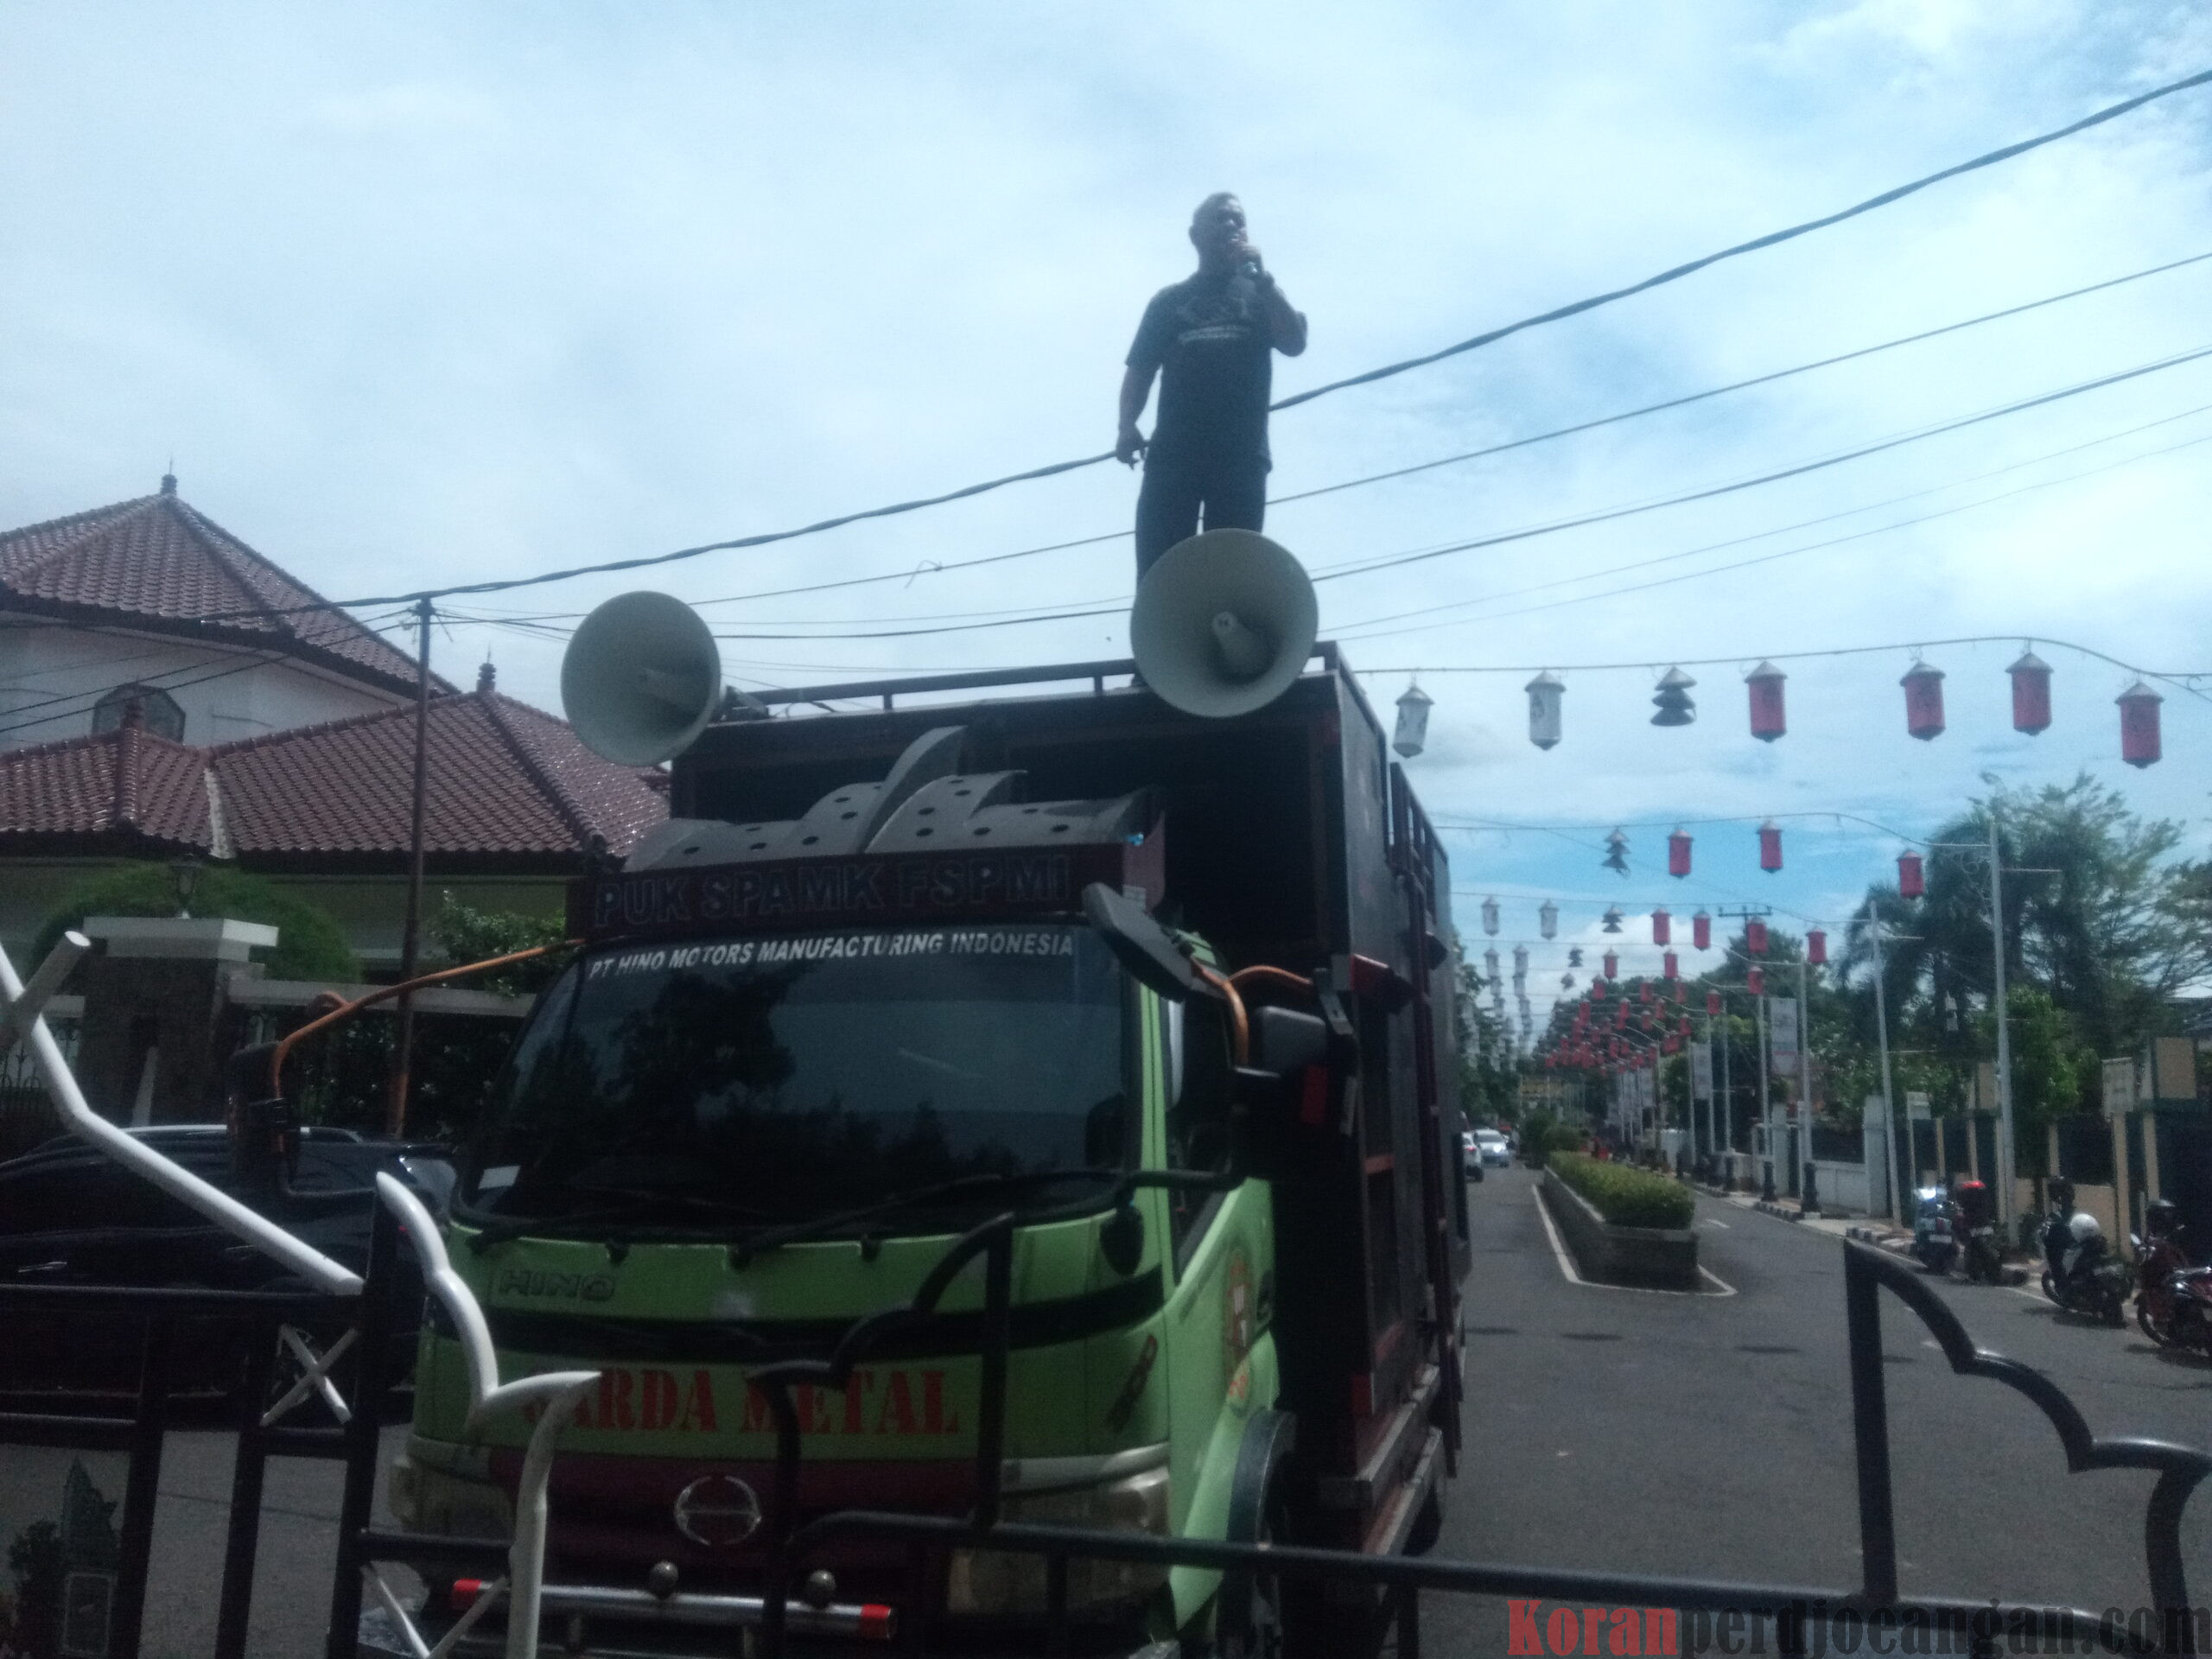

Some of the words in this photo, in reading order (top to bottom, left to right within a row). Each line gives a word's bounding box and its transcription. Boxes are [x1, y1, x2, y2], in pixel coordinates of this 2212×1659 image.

[594, 876, 692, 927] PUK
[700, 861, 888, 918] SPAMK
[899, 854, 1071, 906] FSPMI
[588, 958, 614, 980] PT
[618, 951, 664, 974] HINO
[668, 941, 753, 969] MOTORS
[756, 932, 943, 962] MANUFACTURING
[950, 931, 1074, 956] INDONESIA
[498, 1268, 616, 1302] HINO
[522, 1364, 719, 1432] RDA
